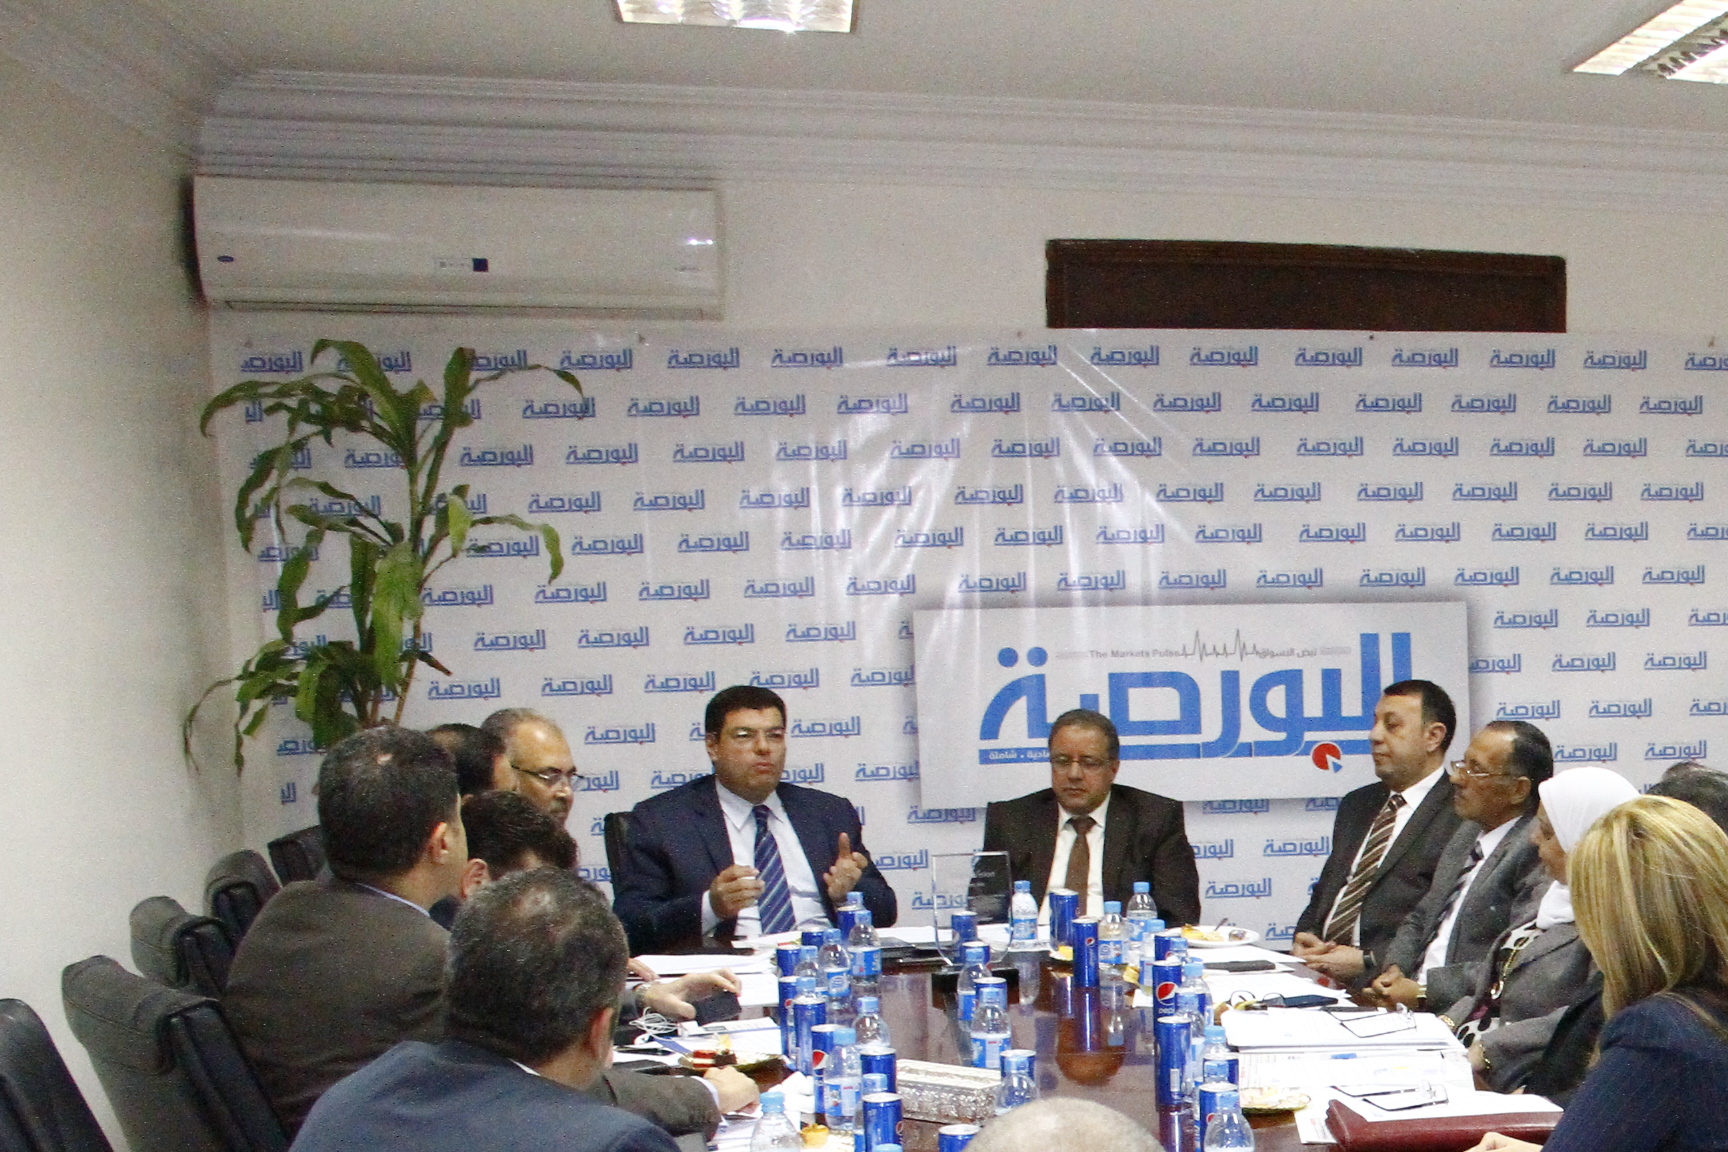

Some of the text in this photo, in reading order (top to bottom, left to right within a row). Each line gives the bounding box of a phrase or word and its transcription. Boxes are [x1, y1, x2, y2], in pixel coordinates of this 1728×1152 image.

[559, 348, 633, 371] البورصة
[668, 348, 740, 369] البورصة
[772, 347, 843, 368] البورصة
[887, 346, 956, 367] البورصة
[987, 345, 1057, 366] البورصة
[1090, 345, 1159, 366] البورصة
[1190, 346, 1258, 366] البورصة
[1295, 347, 1362, 366] البورصة
[1392, 348, 1458, 367] البورصة
[1491, 349, 1555, 368] البورصة
[1584, 350, 1647, 369] البورصة
[523, 397, 596, 419] البورصة
[628, 396, 700, 417] البورصة
[735, 394, 806, 416] البورصة
[837, 394, 908, 414] البورصة
[951, 392, 1020, 413] البورصة
[1052, 392, 1120, 412] البورصة
[1153, 393, 1221, 412] البورصة
[1251, 392, 1319, 412] البورصة
[1356, 393, 1422, 412] البورصة
[1452, 394, 1516, 413] البورصة
[1548, 395, 1611, 413] البورصة
[1640, 396, 1703, 414] البورصة
[460, 445, 533, 467] البورصة
[566, 443, 638, 464] البورصة
[673, 442, 745, 463] البورصة
[777, 440, 847, 461] البورصة
[891, 438, 960, 459] البورصة
[991, 437, 1060, 458] البورصة
[1093, 437, 1162, 456] البورصة
[1193, 437, 1260, 456] البورصة
[1297, 436, 1363, 456] البورصة
[1393, 437, 1459, 456] البورصة
[1491, 437, 1555, 456] البورصة
[1584, 438, 1647, 457] البورصة
[528, 491, 601, 513] البورصة
[634, 489, 705, 511] البورصة
[740, 488, 809, 509] البورصة
[842, 488, 912, 507] البورصة
[956, 484, 1023, 504] البورصة
[1055, 483, 1123, 503] البورصة
[1157, 483, 1224, 502] البورصة
[1254, 482, 1321, 502] البورصة
[1358, 482, 1423, 501] البورصة
[1453, 482, 1517, 501] البورصة
[1549, 483, 1612, 501] البورصة
[1641, 482, 1704, 501] البورصة
[781, 529, 851, 550] البورصة
[895, 526, 964, 548] البورصة
[995, 525, 1063, 546] البورصة
[1097, 524, 1165, 544] البورصة
[1195, 524, 1263, 543] البورصة
[1299, 522, 1366, 543] البورصة
[1396, 522, 1460, 541] البورصة
[1492, 522, 1556, 541] البورصة
[1585, 521, 1648, 541] البورصة
[571, 534, 643, 555] البورصة
[678, 531, 749, 553] البورصة
[846, 574, 916, 596] البورصة
[958, 571, 1027, 593] البورصة
[1058, 570, 1126, 591] البورصة
[1159, 569, 1226, 590] البورصة
[1257, 568, 1323, 588] البورصة
[1360, 568, 1425, 587] البورصة
[1455, 566, 1519, 586] البورصة
[1551, 566, 1614, 585] البورصة
[1643, 565, 1705, 584] البورصة
[422, 584, 493, 606] البورصة
[535, 582, 607, 603] البورصة
[639, 579, 710, 601] البورصة
[744, 577, 814, 598] البورصة
[1494, 609, 1559, 629] البورصة
[1587, 608, 1650, 627] البورصة
[474, 630, 546, 651] البورصة
[578, 627, 649, 648] البورصة
[684, 623, 755, 645] البورصة
[786, 621, 856, 642] البورصة
[1090, 650, 1108, 658] The
[1111, 649, 1150, 658] Markets
[1552, 652, 1616, 672] البورصة
[1645, 651, 1707, 670] البورصة
[428, 678, 501, 700] البورصة
[541, 674, 613, 696] البورصة
[644, 671, 716, 692] البورصة
[1496, 699, 1561, 720] البورصة
[1589, 699, 1652, 718] البورصة
[585, 723, 656, 745] البورصة
[791, 716, 861, 738] البورصة
[1555, 742, 1617, 763] البورصة
[1645, 740, 1707, 762] البورصة
[1263, 836, 1333, 860] البورصة
[1205, 878, 1272, 899] البورصة
